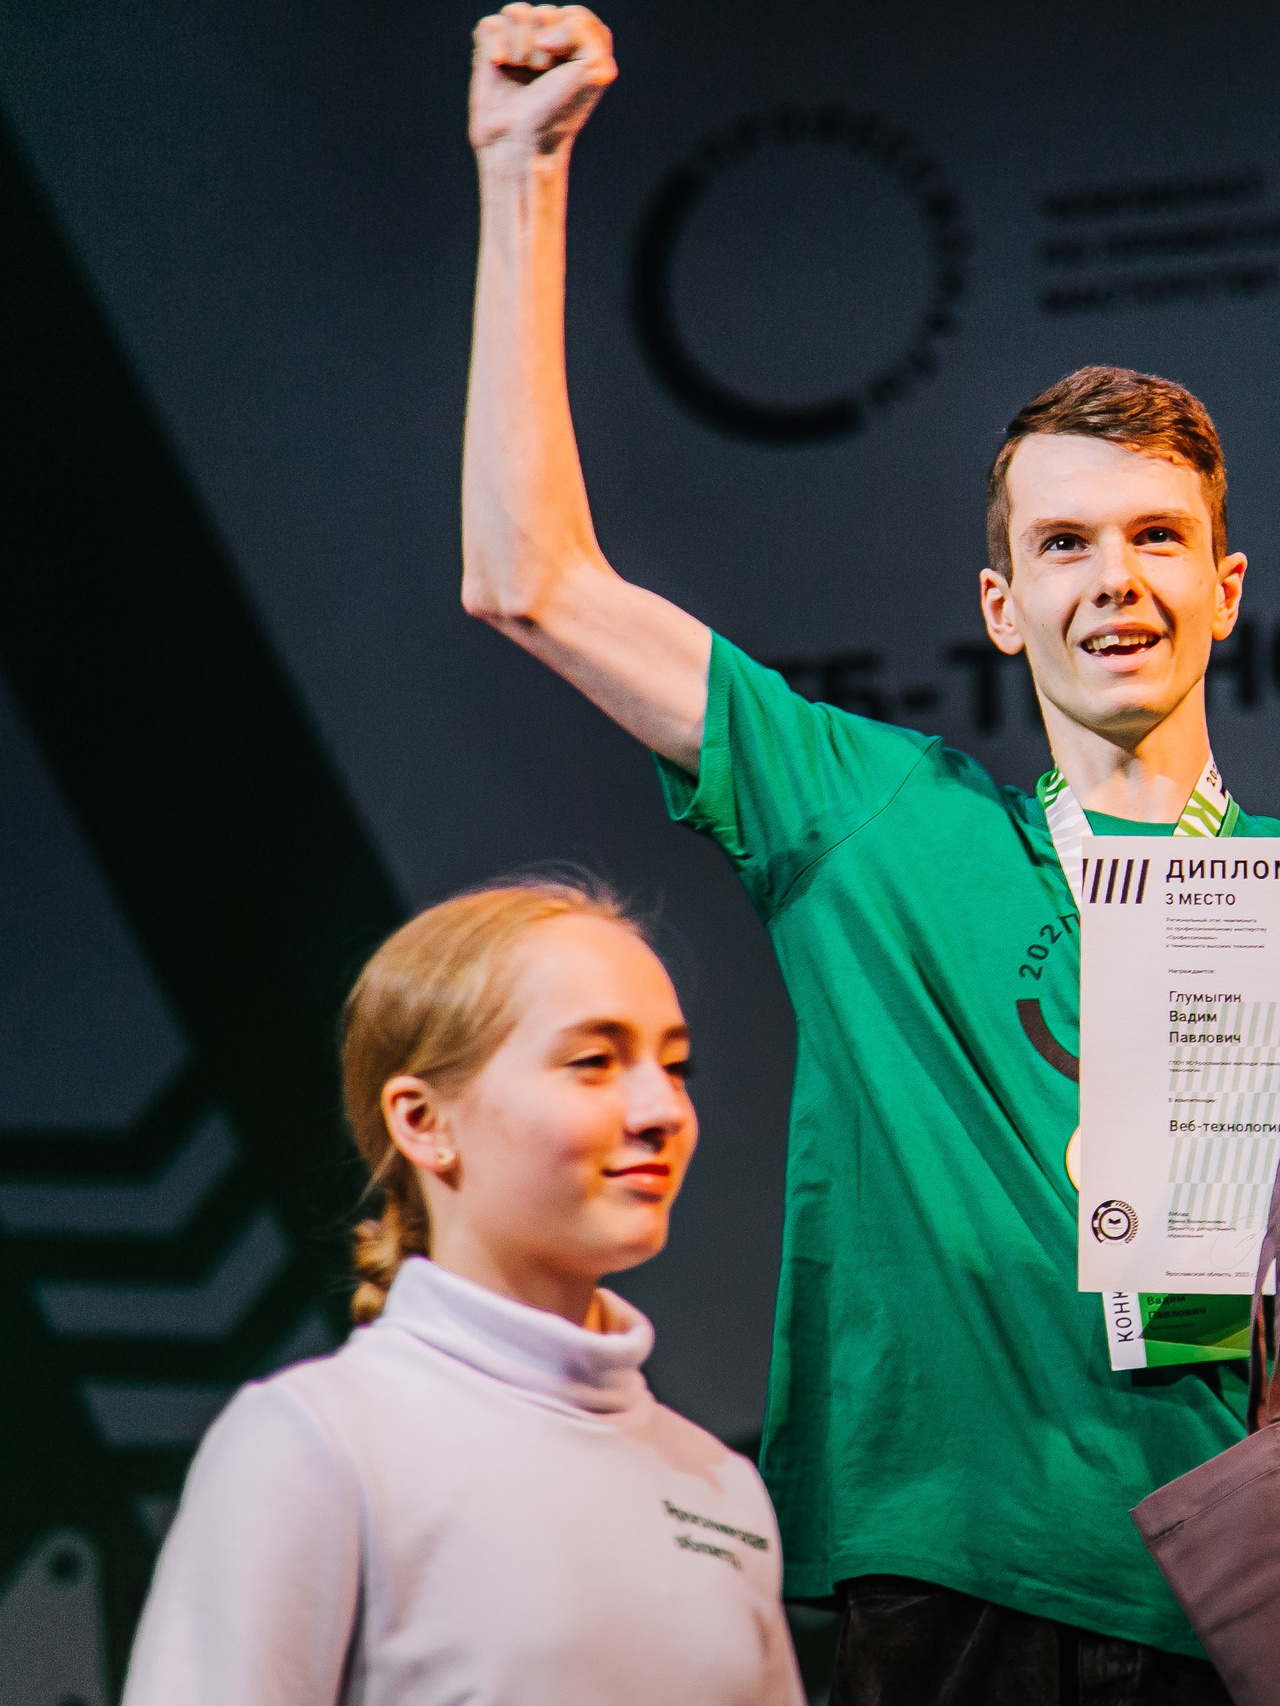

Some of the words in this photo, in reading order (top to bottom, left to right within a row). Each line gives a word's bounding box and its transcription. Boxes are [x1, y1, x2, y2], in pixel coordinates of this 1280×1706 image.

[1165, 892, 1175, 906] 3
[1178, 892, 1237, 906] МЕСТО
[1168, 990, 1242, 1006] Глумыгин
[1168, 1010, 1218, 1025] Вадим
[1168, 1031, 1242, 1044] Павлович
[1146, 1295, 1187, 1306] Вадим
[1148, 1308, 1207, 1320] Павлович
